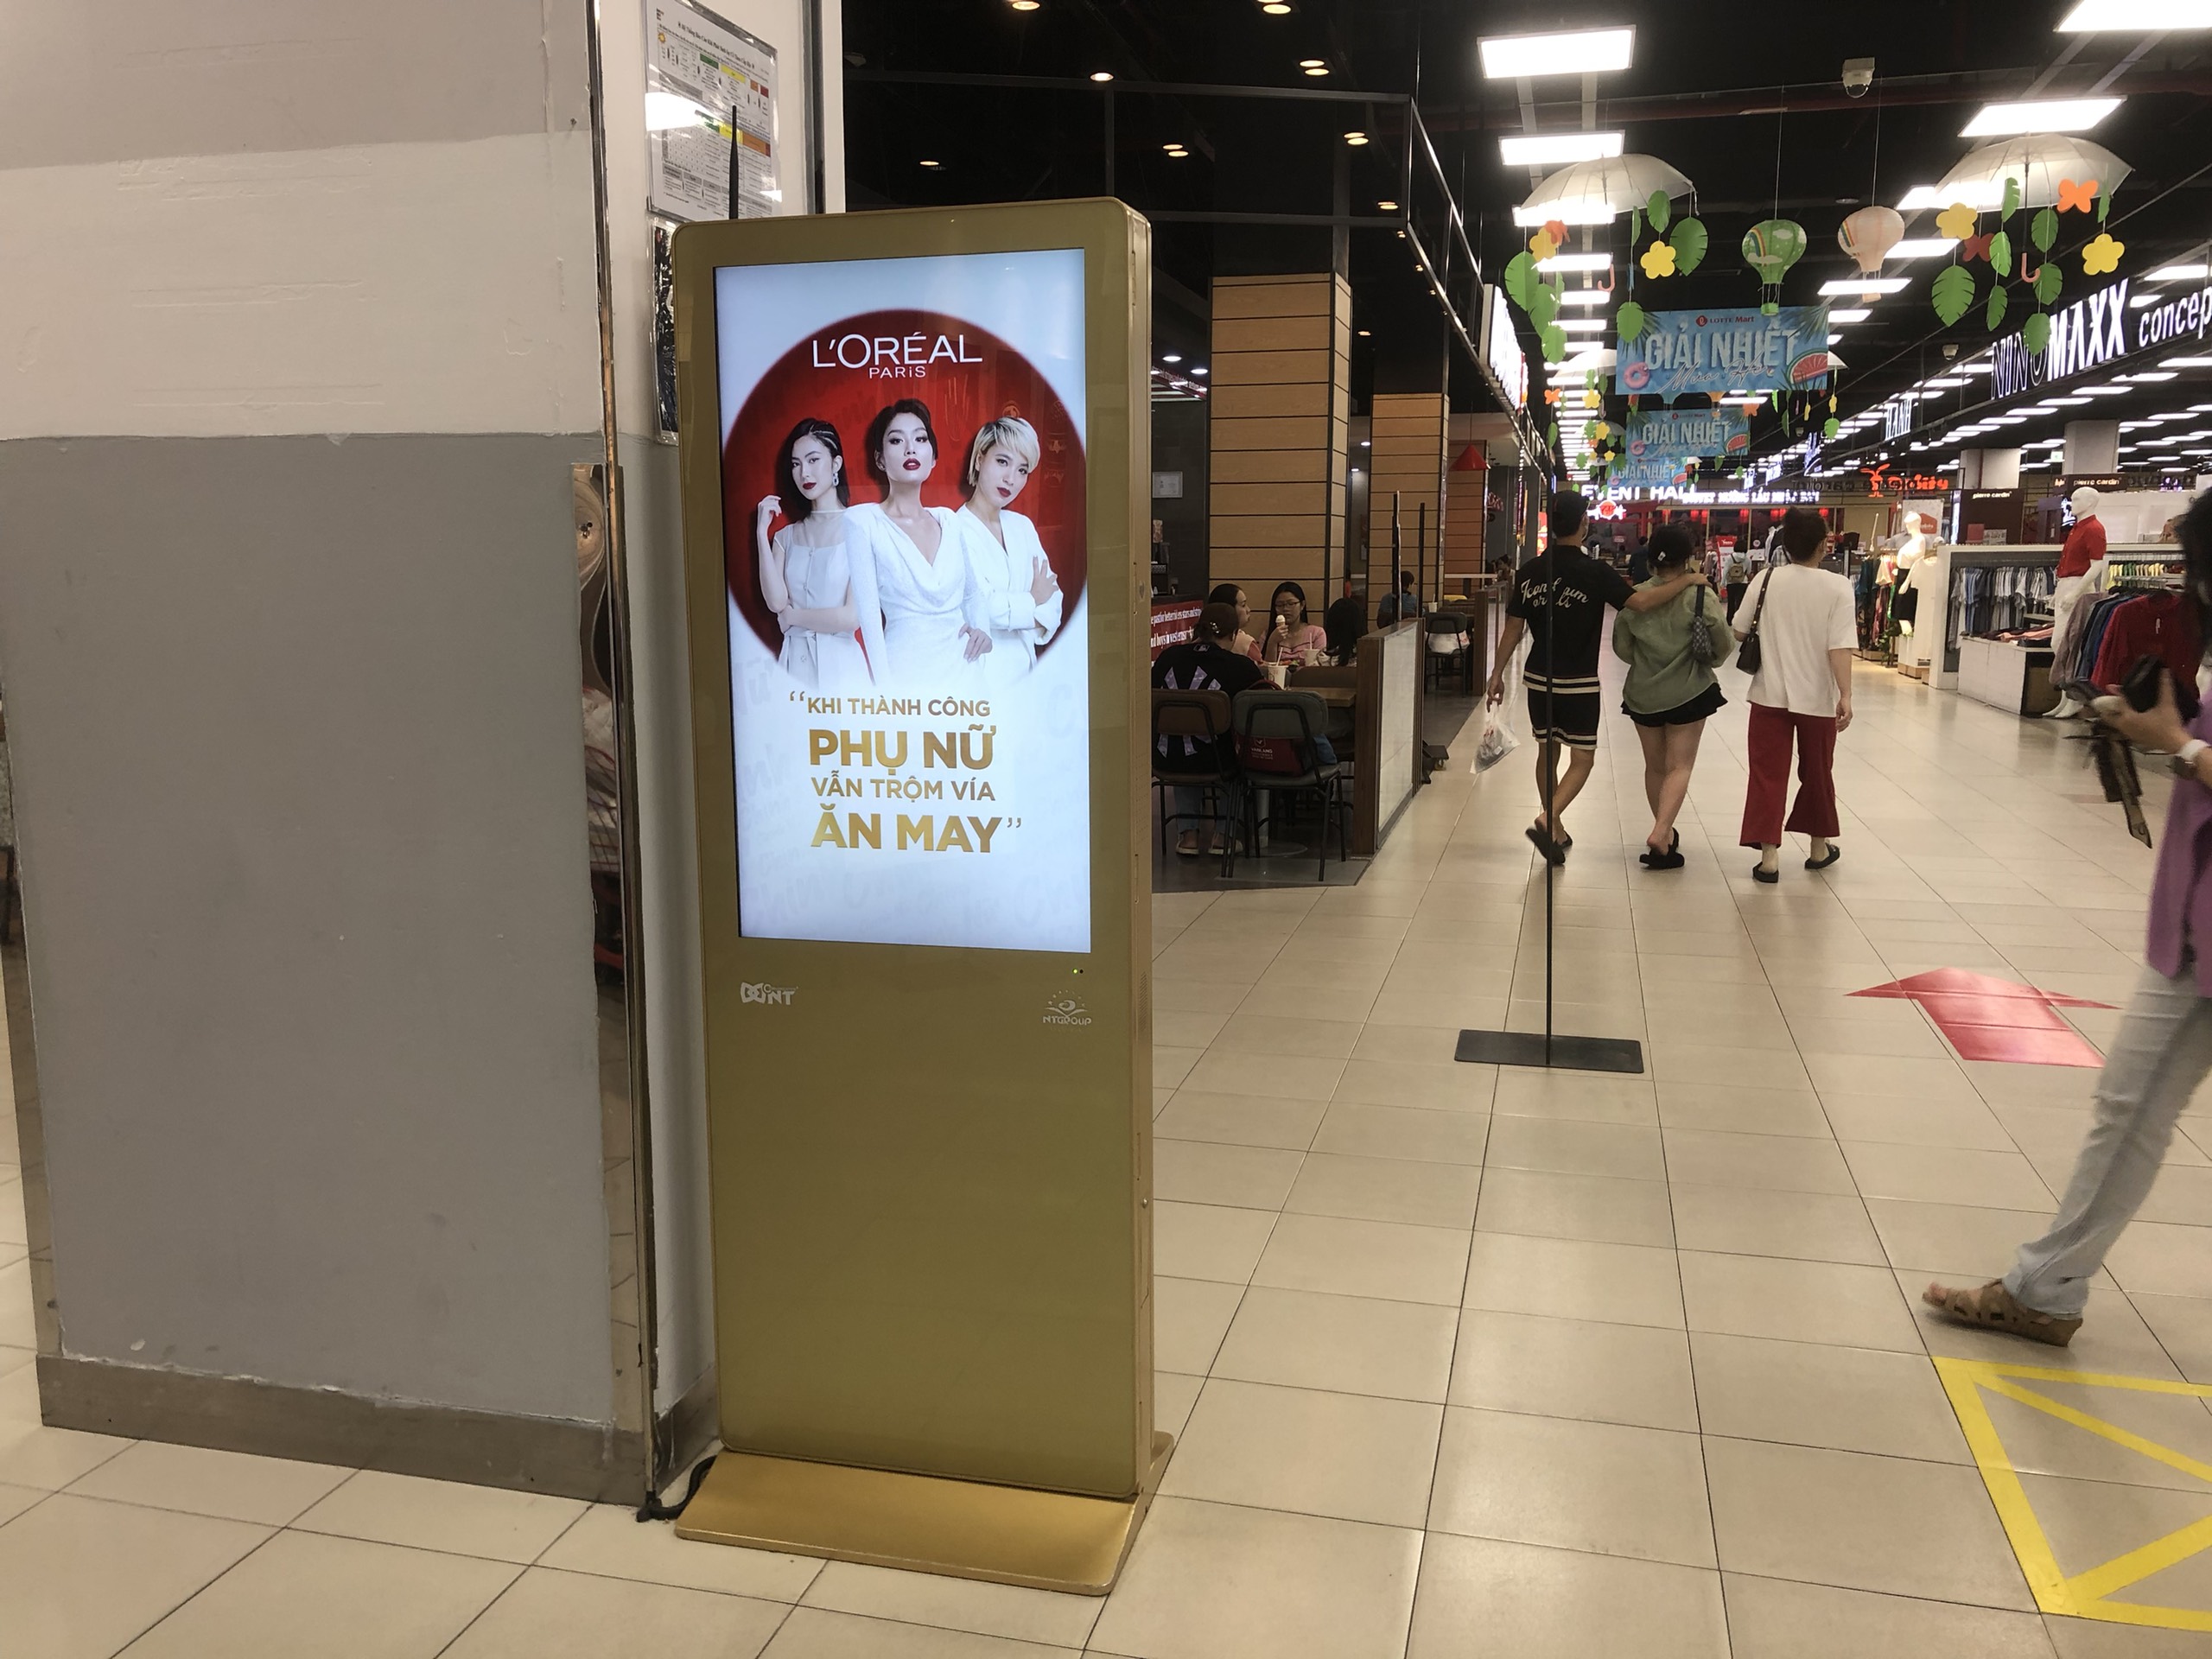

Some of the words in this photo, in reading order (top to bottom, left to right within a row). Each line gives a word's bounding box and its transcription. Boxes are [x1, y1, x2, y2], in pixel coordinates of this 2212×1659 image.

[812, 332, 983, 369] L'ORÉAL
[1645, 321, 1702, 370] GIẢI
[848, 695, 921, 716] THÀNH
[927, 696, 991, 717] CÔNG
[809, 728, 908, 776] PHỤ
[923, 723, 997, 770] NỮ
[810, 770, 862, 798] VẪN
[870, 775, 943, 803] TRỘM
[950, 778, 996, 801] VÍA
[810, 803, 881, 849] ĂN
